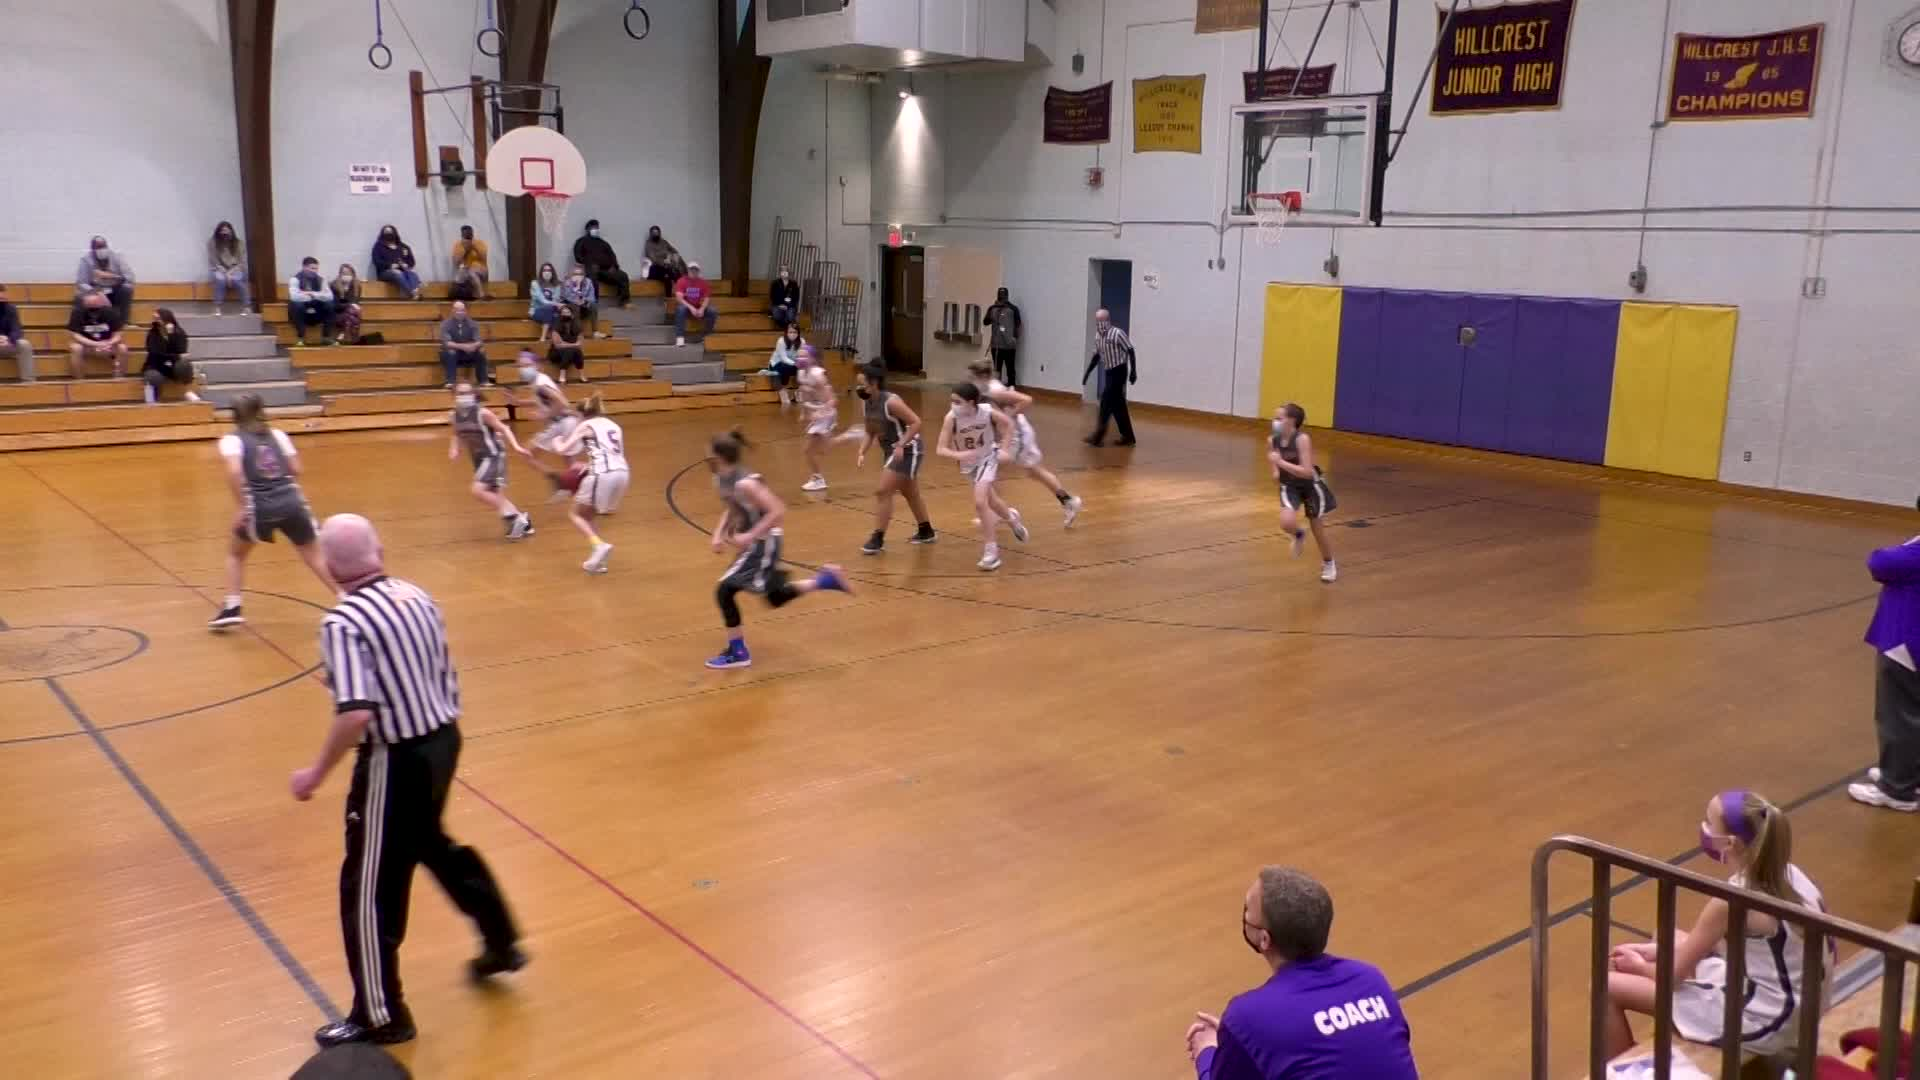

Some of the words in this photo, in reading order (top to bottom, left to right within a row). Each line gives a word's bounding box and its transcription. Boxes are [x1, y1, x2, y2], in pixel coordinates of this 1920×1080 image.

[1454, 20, 1551, 55] HILLCREST
[1683, 40, 1760, 60] HILLCREST
[1442, 64, 1503, 96] JUNIOR
[1512, 62, 1554, 92] HIGH
[1676, 88, 1805, 112] CHAMPIONS
[608, 430, 621, 453] 5
[1313, 995, 1391, 1035] COACH
